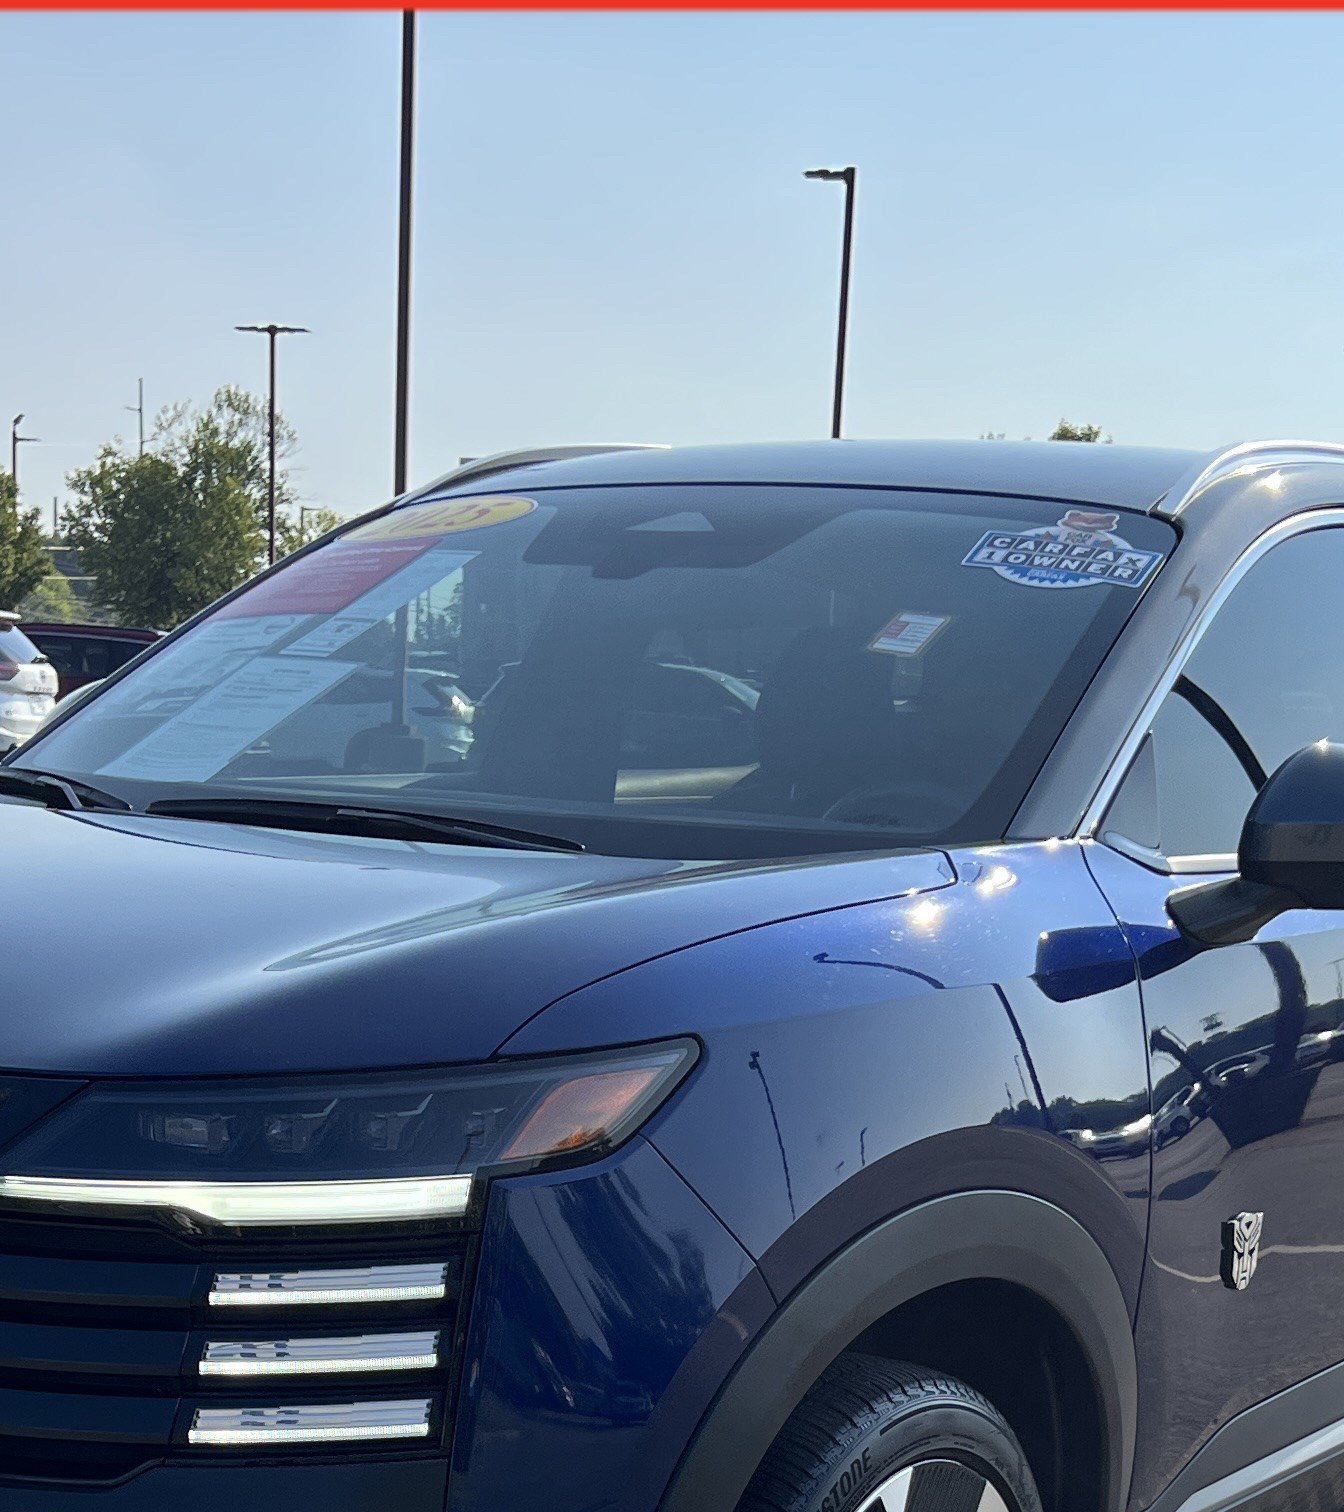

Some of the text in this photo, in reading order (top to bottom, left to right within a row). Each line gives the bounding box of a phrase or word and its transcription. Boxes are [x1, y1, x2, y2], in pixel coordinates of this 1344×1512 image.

[981, 550, 998, 561] 1
[1006, 552, 1135, 579] OWNER
[992, 537, 1144, 569] CARFAX
